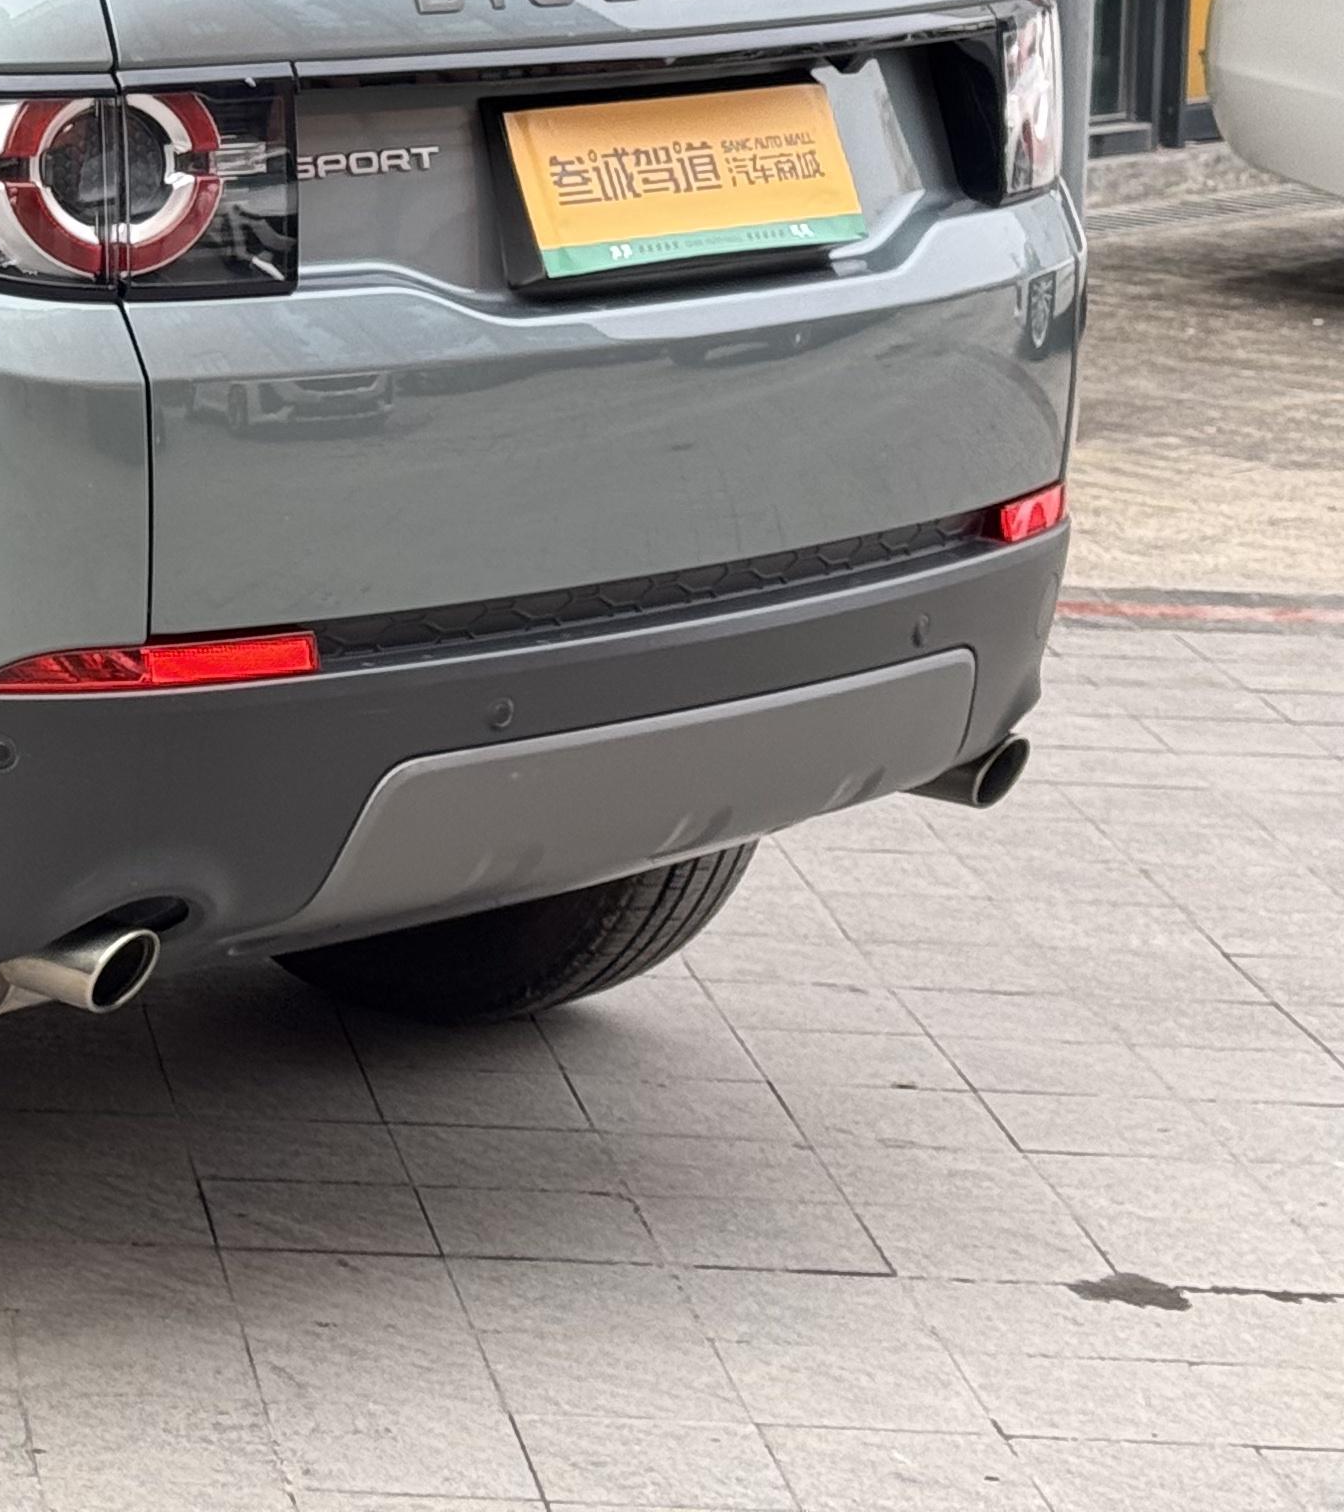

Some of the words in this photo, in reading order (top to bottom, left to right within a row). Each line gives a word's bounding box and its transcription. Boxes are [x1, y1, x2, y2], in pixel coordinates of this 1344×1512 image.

[754, 136, 783, 150] AUTO
[784, 133, 815, 146] MALL
[296, 146, 440, 180] SPORT
[724, 150, 825, 187] 汽车商城
